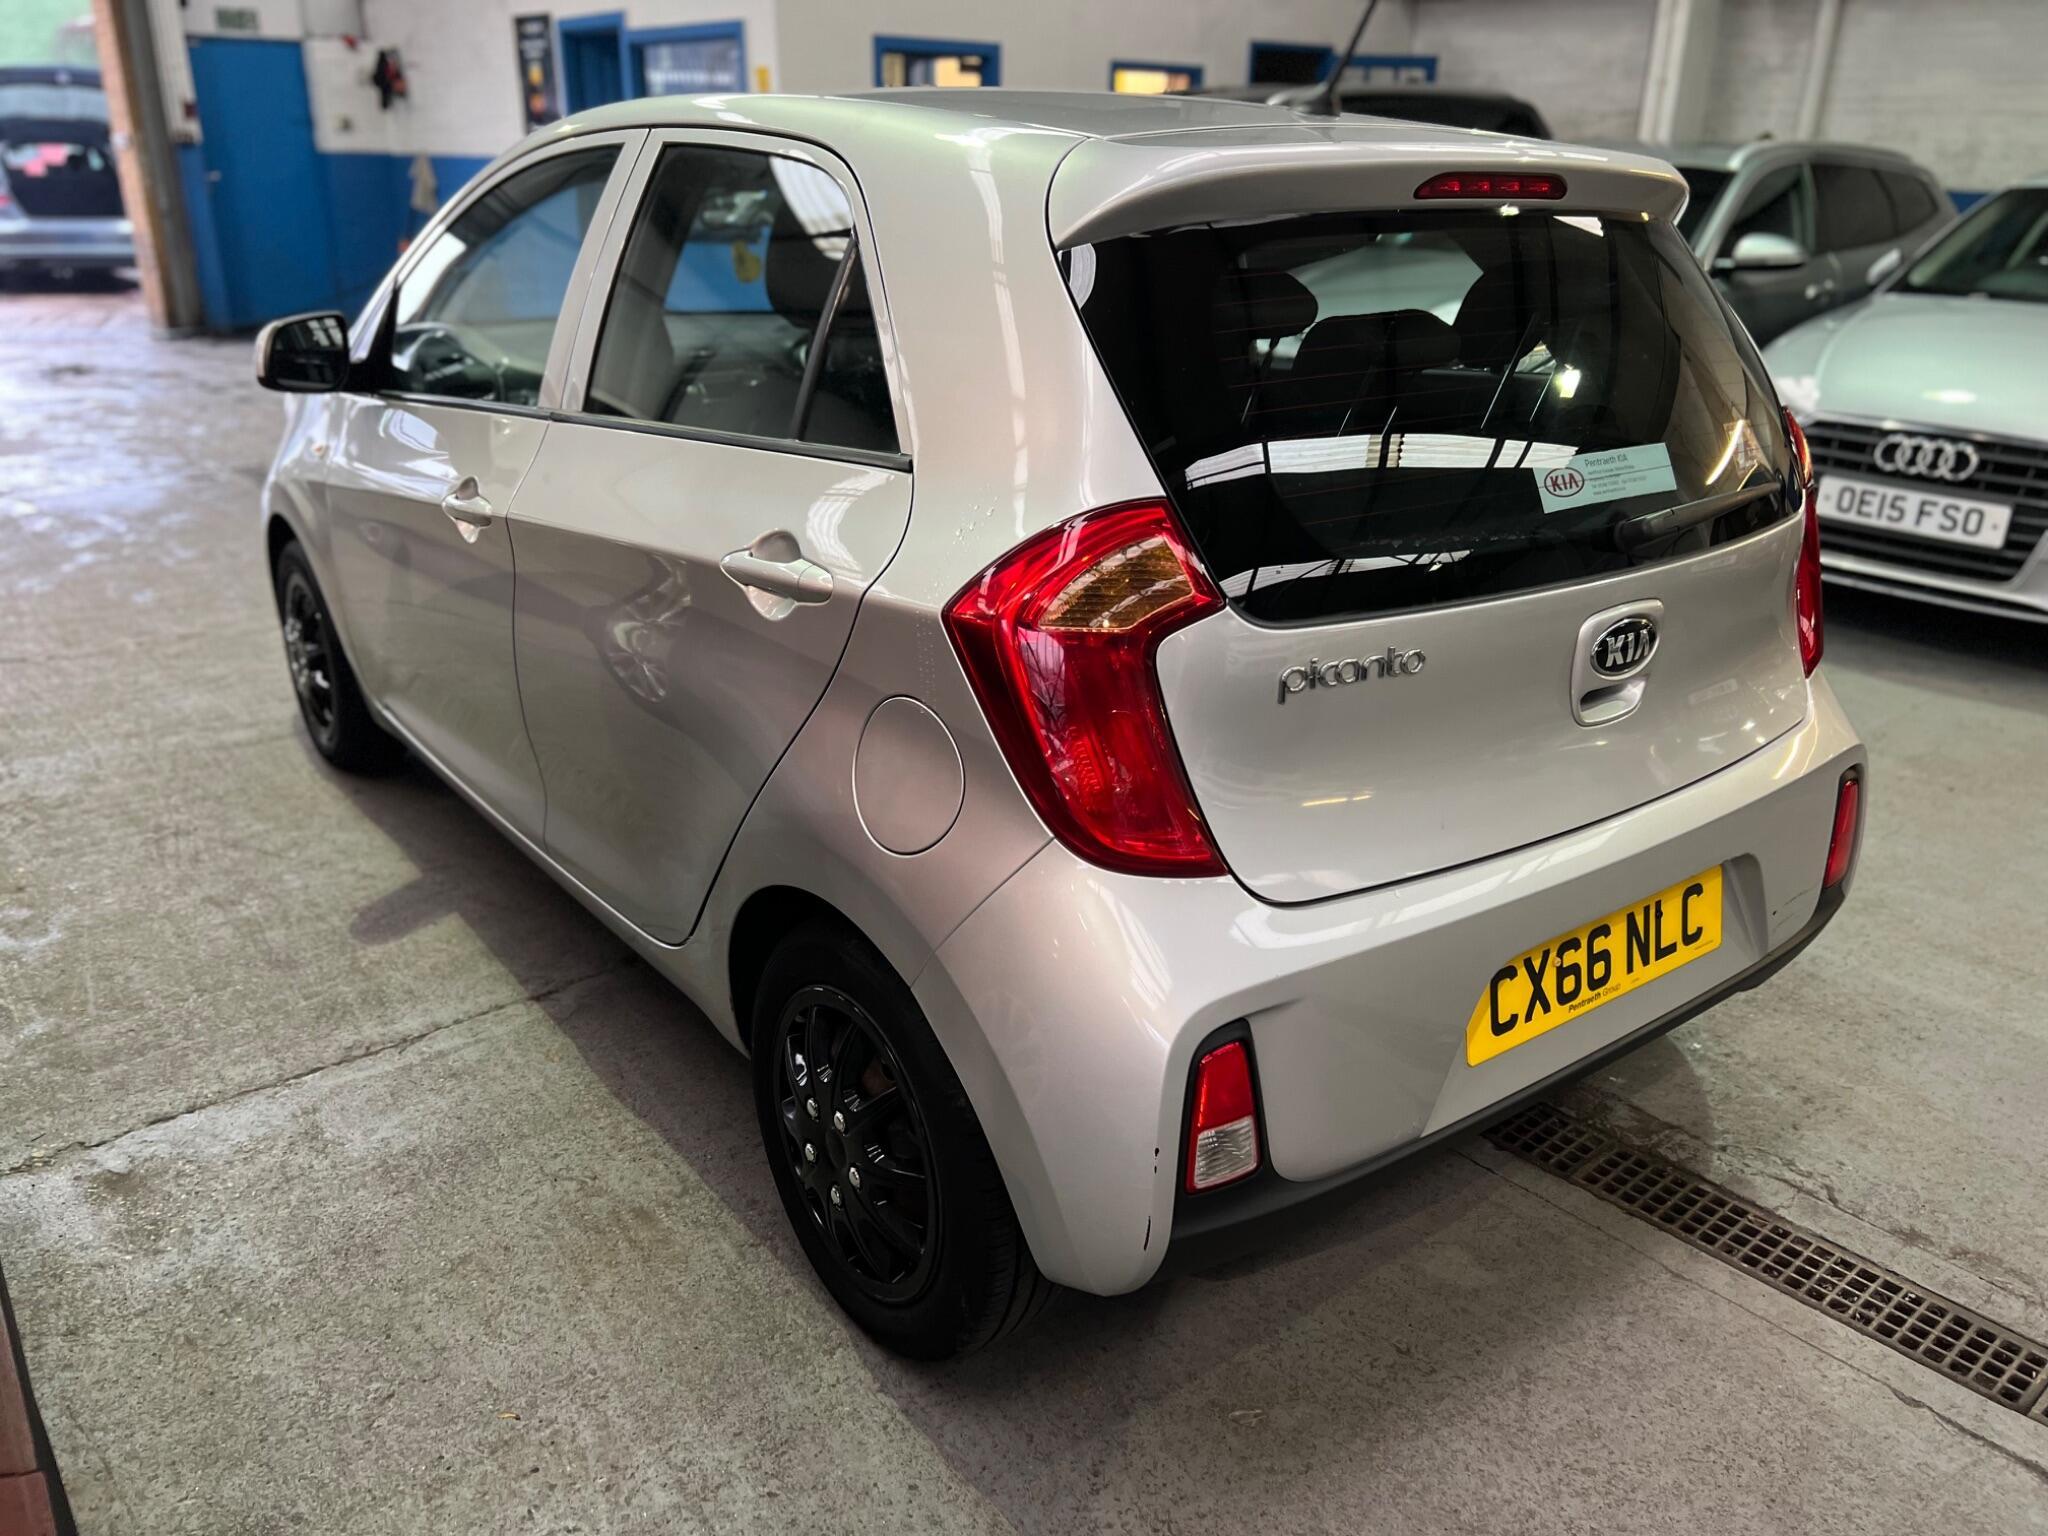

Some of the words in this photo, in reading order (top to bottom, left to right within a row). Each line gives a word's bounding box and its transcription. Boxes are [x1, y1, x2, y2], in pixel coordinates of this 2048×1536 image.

[1550, 473, 1579, 492] KIA
[1836, 486, 1907, 524] OE15
[1914, 499, 1985, 537] FSO
[1605, 629, 1650, 668] KIA
[1277, 646, 1426, 705] picanto
[1490, 924, 1611, 1037] CX66
[1627, 883, 1703, 975] NLC
[1568, 992, 1601, 1013] Pentraeth
